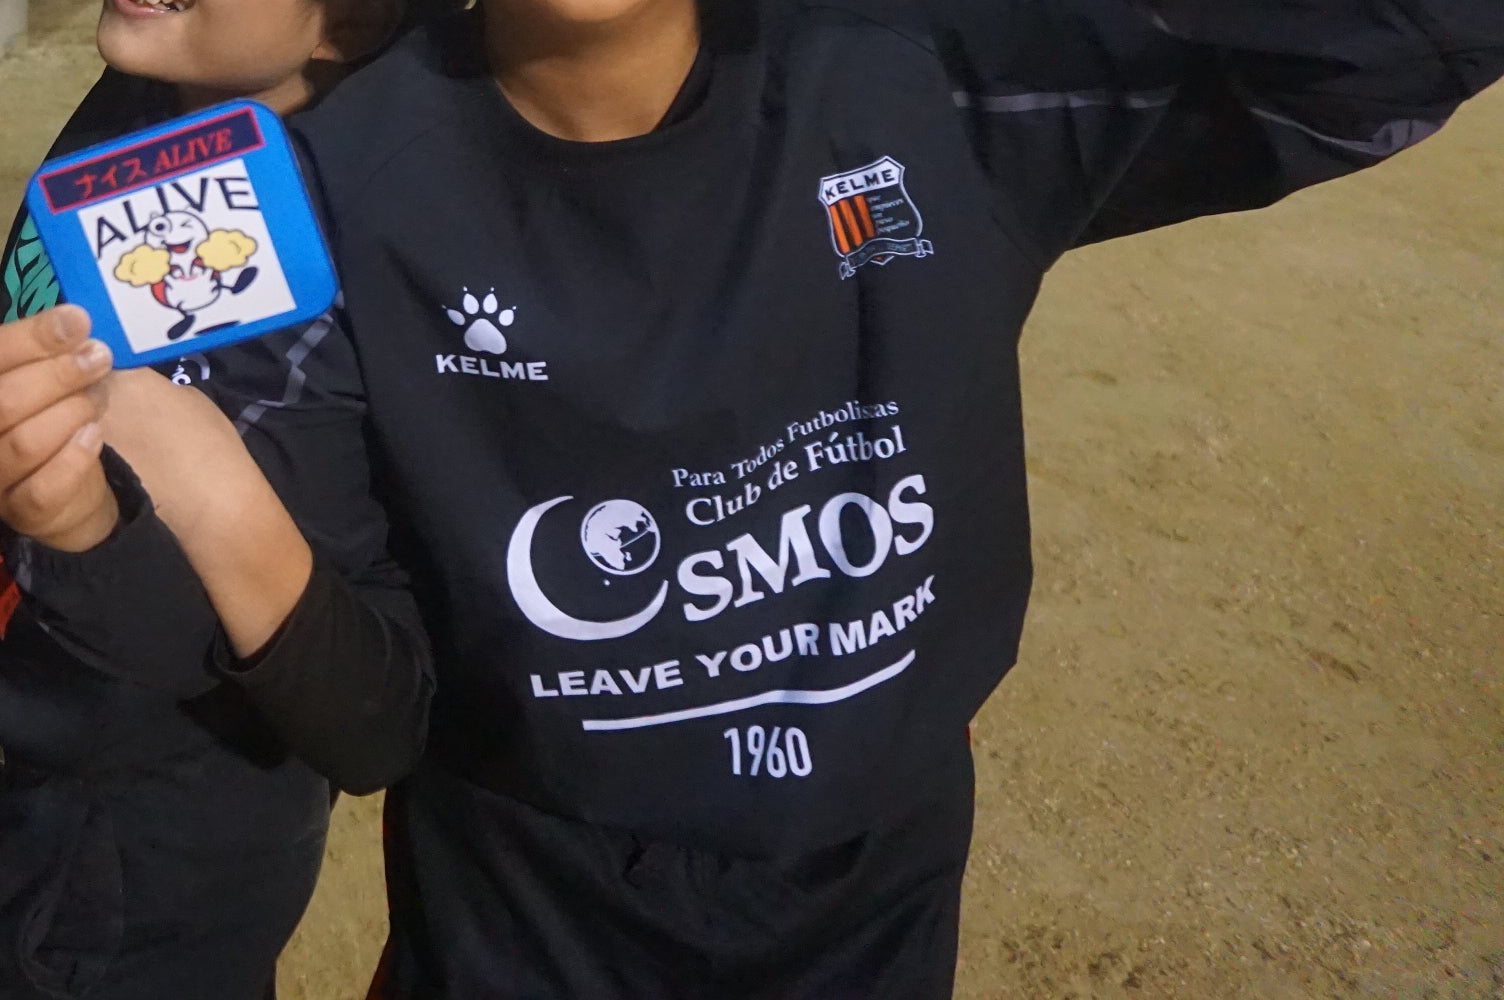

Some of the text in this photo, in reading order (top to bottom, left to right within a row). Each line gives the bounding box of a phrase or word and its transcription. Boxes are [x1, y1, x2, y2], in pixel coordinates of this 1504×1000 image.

[74, 127, 234, 199] ナイス ALIVE
[824, 168, 896, 201] KELME
[96, 176, 261, 259] ALIVE
[436, 354, 549, 382] KELME
[671, 467, 726, 488] Para
[731, 438, 786, 480] Todos
[685, 424, 908, 526] Club de Fútbol
[530, 574, 936, 698] LEAVE YOUR MARK
[723, 725, 814, 779] 1960
